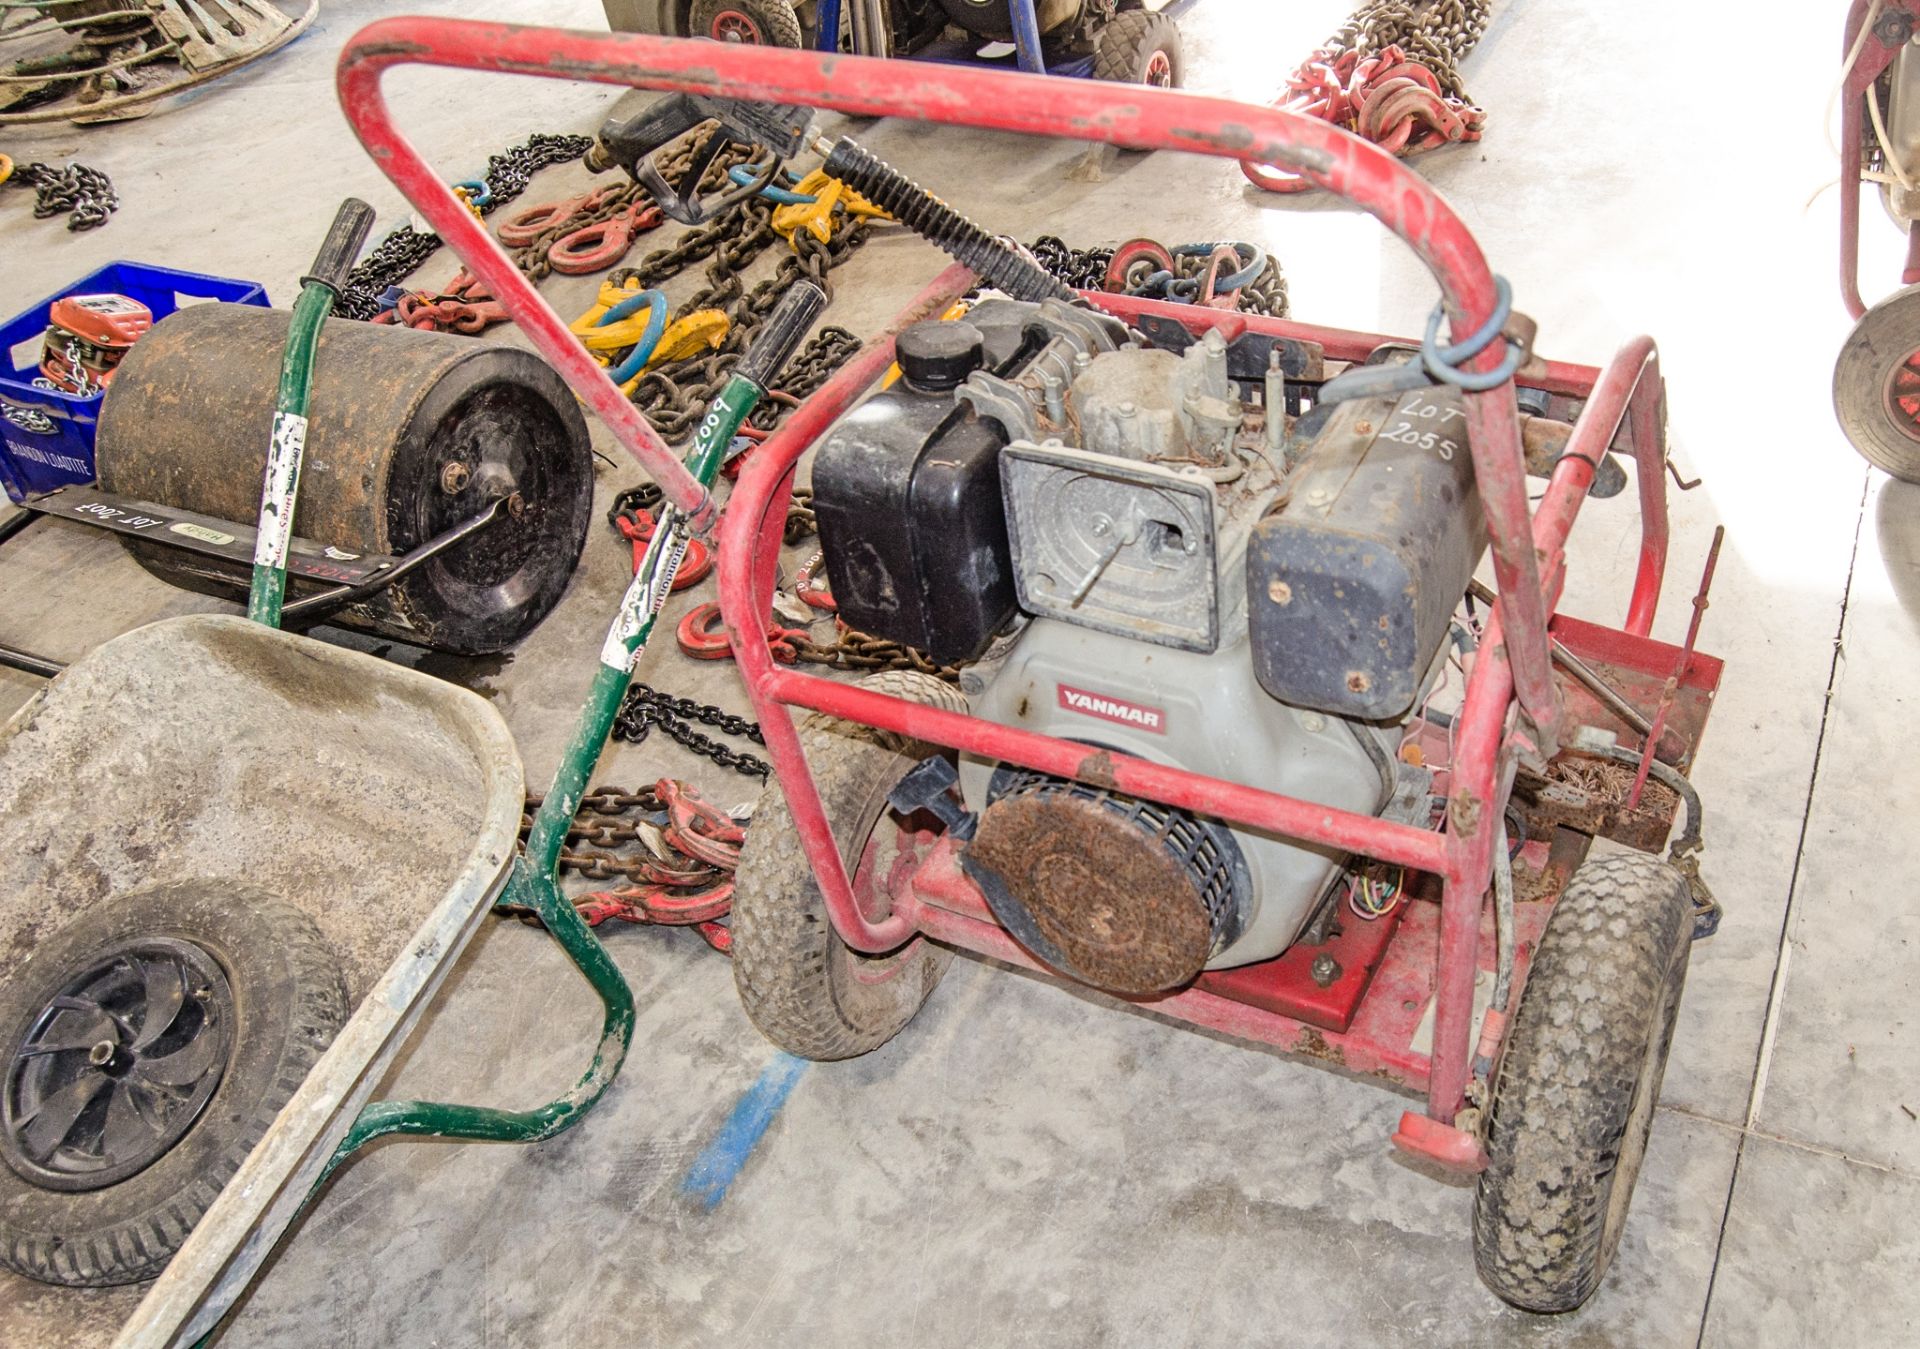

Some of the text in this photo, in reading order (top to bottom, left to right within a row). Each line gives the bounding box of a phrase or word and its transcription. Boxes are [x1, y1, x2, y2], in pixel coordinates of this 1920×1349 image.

[1400, 398, 1466, 422] LOT
[1378, 422, 1458, 461] 2055
[74, 502, 164, 529] LOT 2007
[1064, 690, 1159, 727] YANMAR
